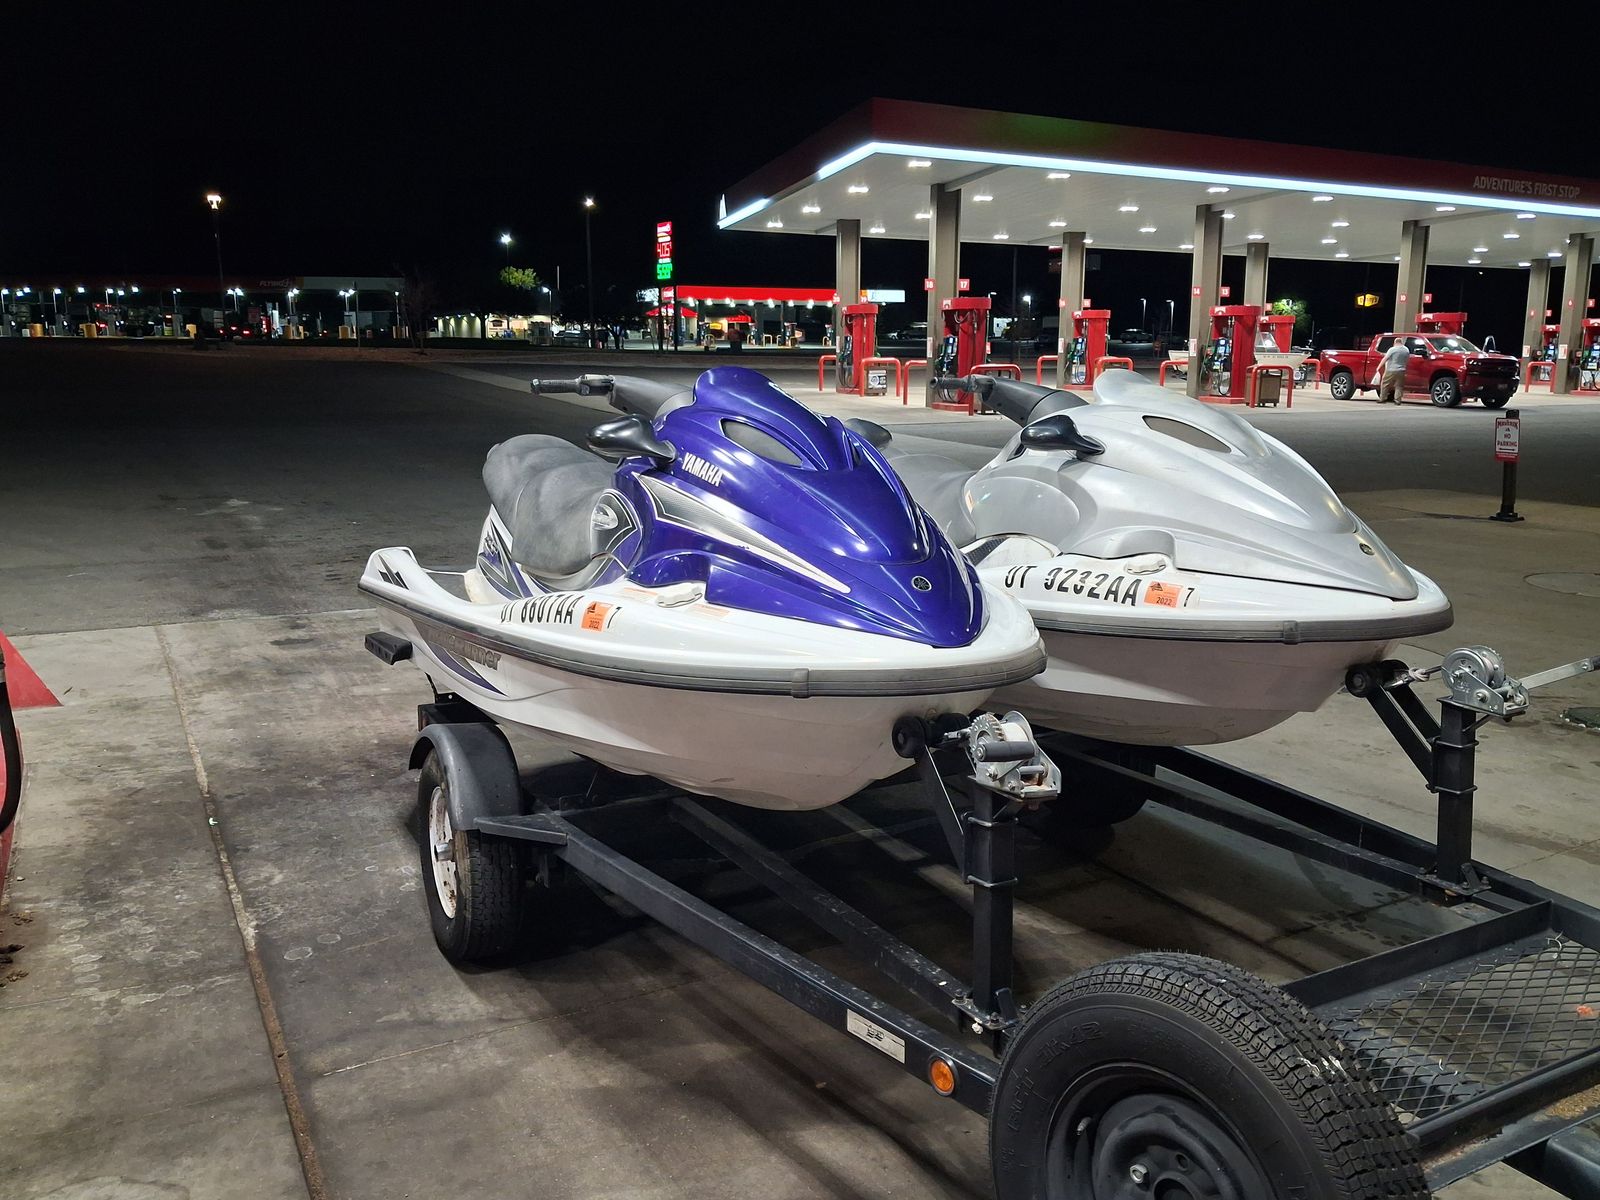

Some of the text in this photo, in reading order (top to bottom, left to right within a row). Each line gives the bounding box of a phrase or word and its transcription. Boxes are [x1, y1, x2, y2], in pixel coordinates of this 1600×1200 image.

[1473, 176, 1580, 199] ADVENTURE'S FIRST STOP
[926, 281, 934, 289] 18
[960, 281, 968, 289] 17
[681, 452, 724, 487] YAMAHA
[1004, 565, 1037, 589] UT
[1183, 587, 1196, 607] 7
[1156, 596, 1172, 606] 2022
[607, 606, 623, 629] 7
